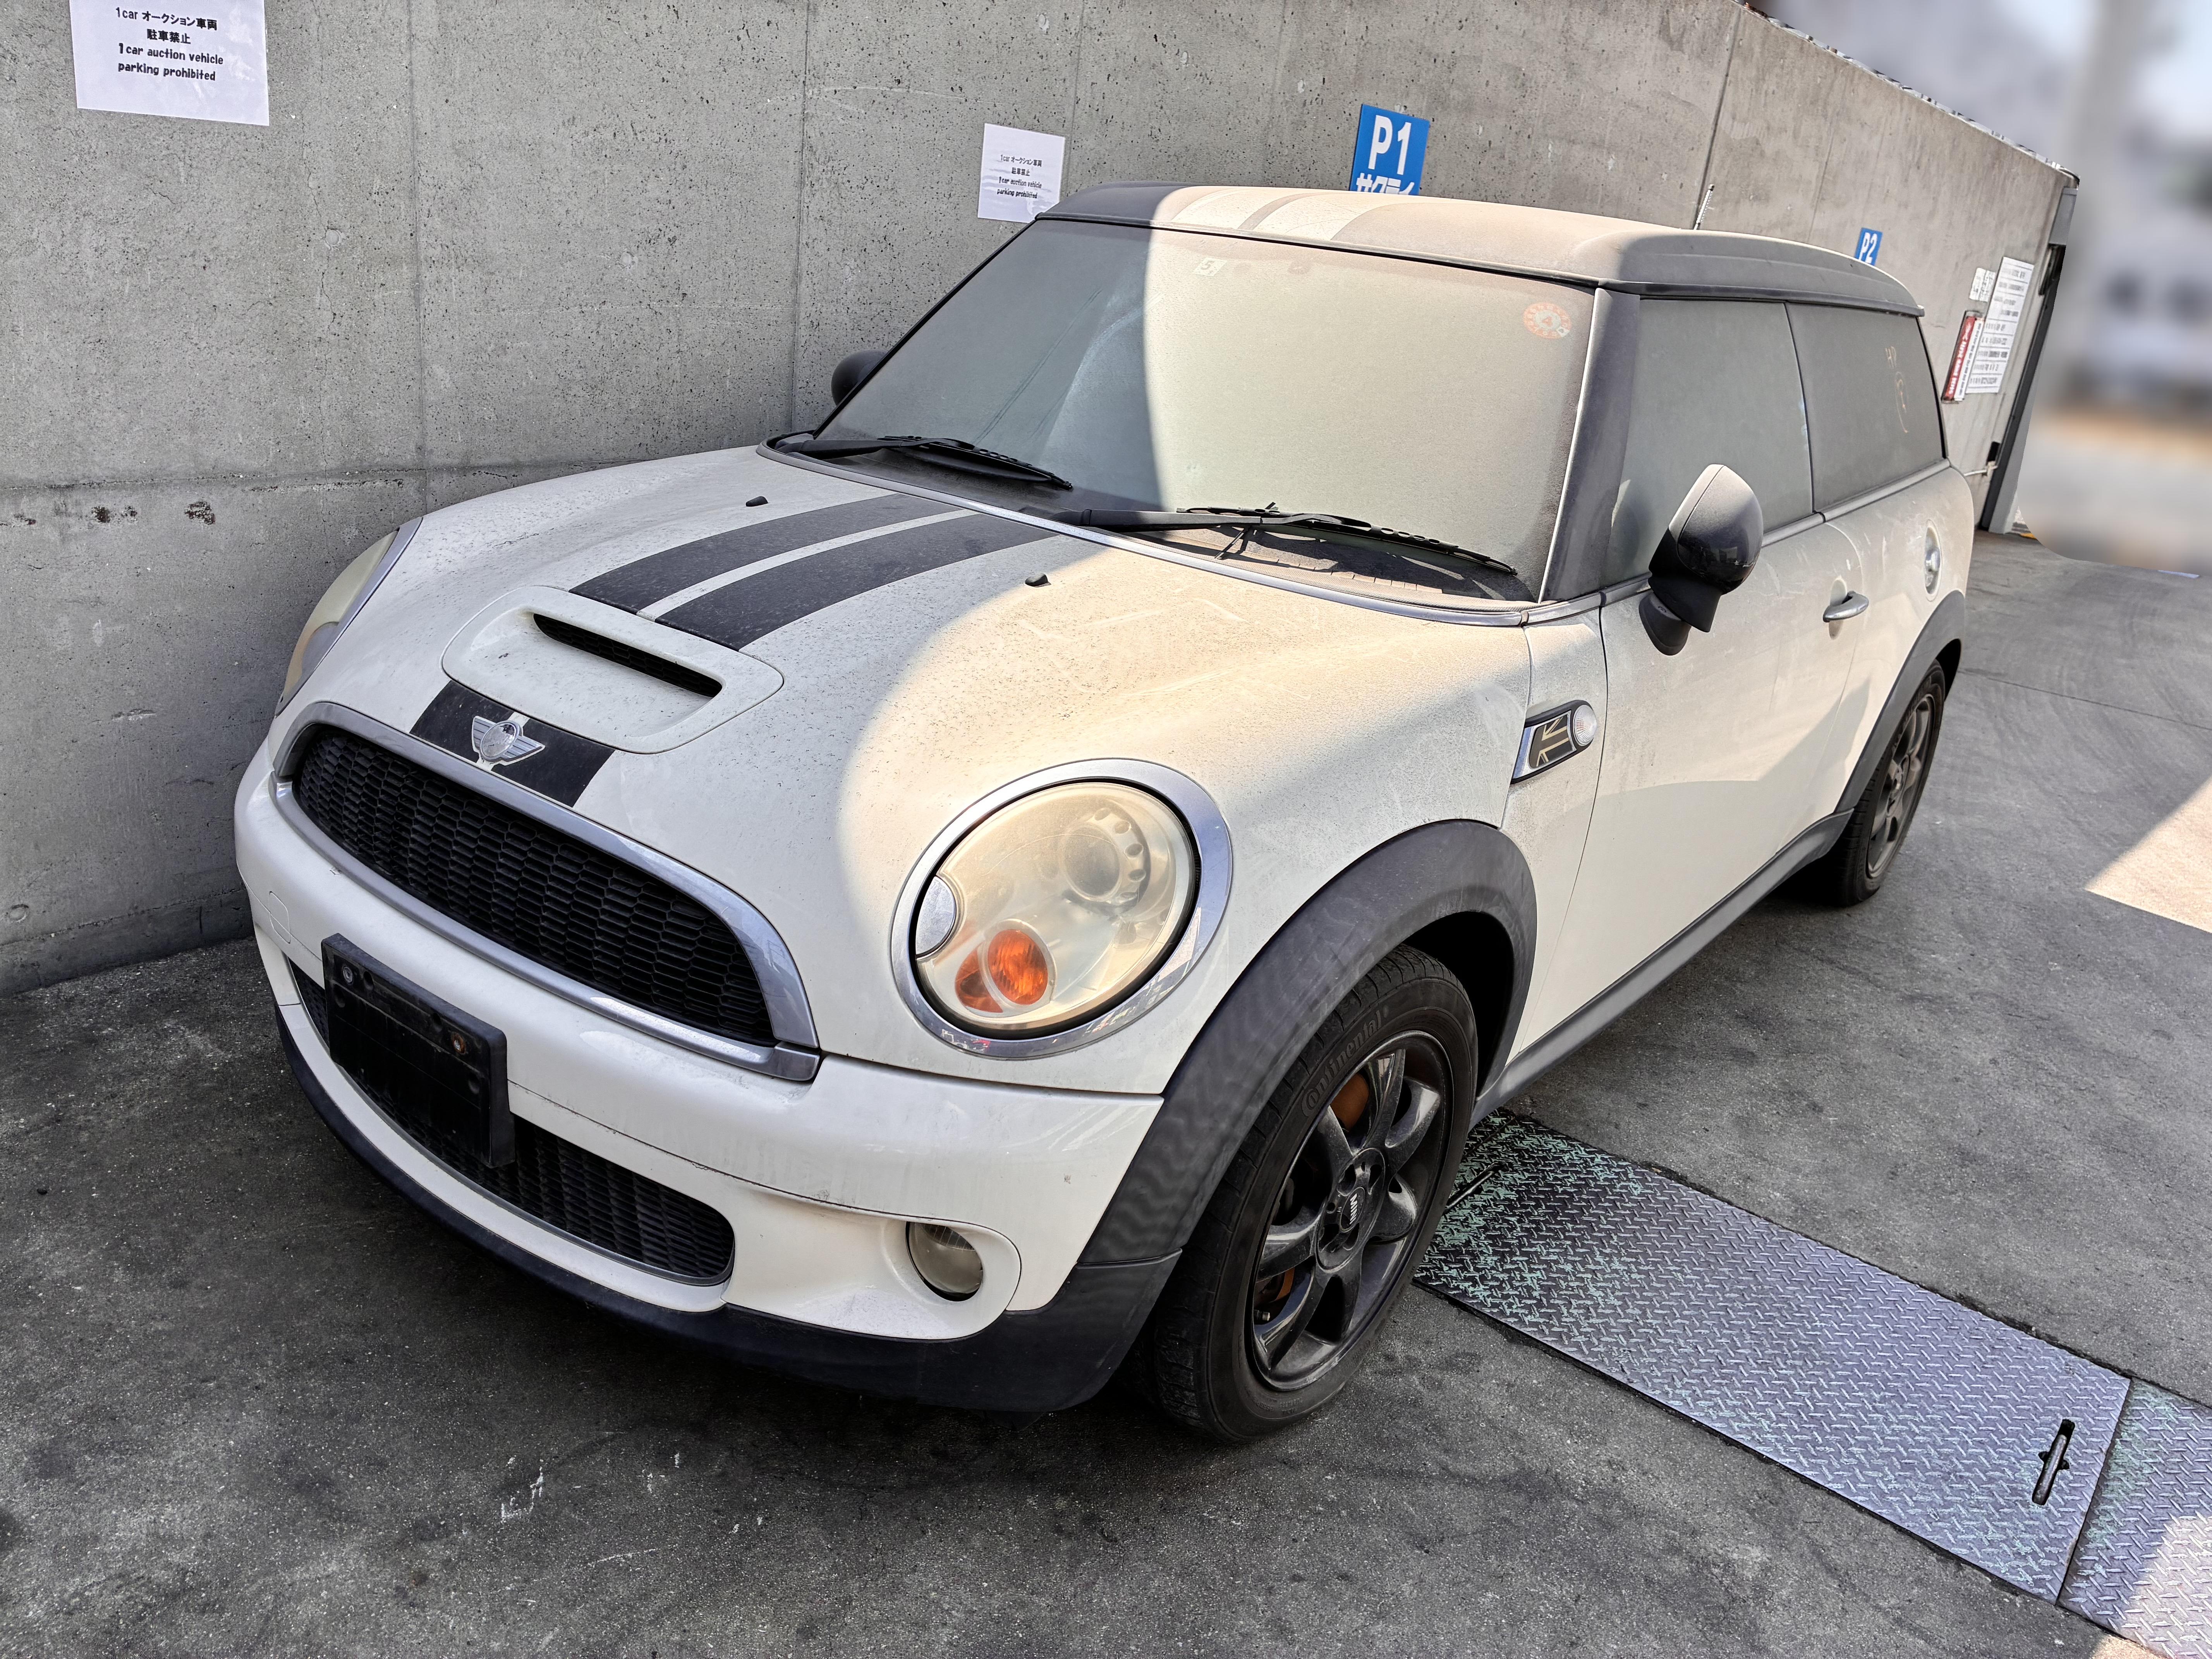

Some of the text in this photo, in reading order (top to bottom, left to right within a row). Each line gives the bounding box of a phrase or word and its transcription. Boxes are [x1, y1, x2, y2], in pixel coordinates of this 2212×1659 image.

[116, 7, 218, 31] 1car オークション車両
[147, 29, 191, 44] 駐車禁止
[147, 47, 185, 60] auction
[189, 52, 223, 65] vehicle
[118, 62, 215, 81] parking prohibited
[1368, 115, 1412, 175] P1
[997, 188, 1037, 199] parking prohibited
[1858, 232, 1877, 263] P2
[1302, 1010, 1382, 1117] Continental
[1349, 1193, 1358, 1224] MINI
